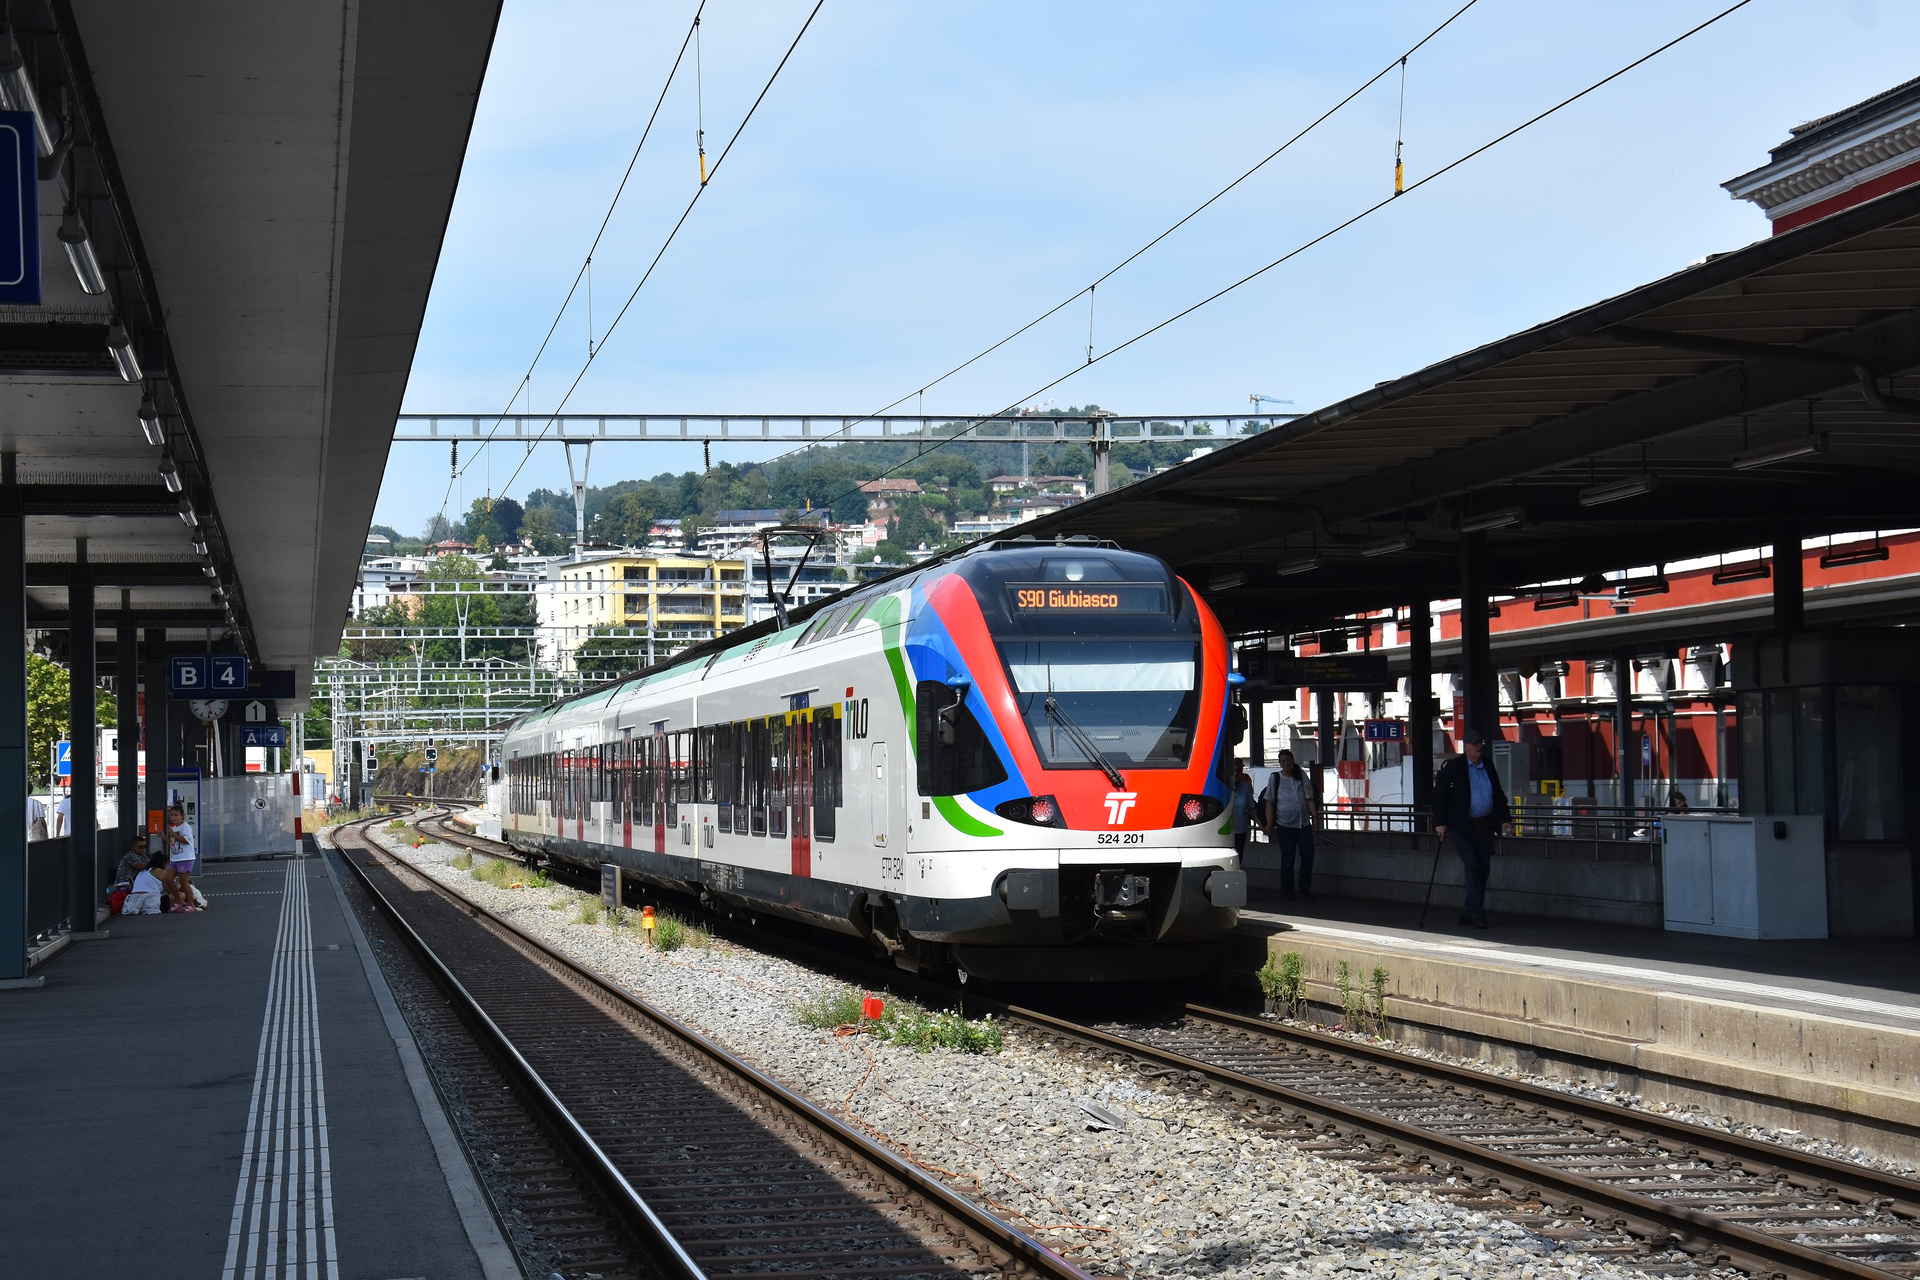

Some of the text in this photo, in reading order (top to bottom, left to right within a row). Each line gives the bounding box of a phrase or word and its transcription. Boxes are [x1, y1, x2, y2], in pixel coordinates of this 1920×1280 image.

[1017, 590, 1118, 608] S90 Giubiasco
[181, 667, 197, 685] B
[221, 667, 235, 685] 4
[252, 704, 258, 720] 1
[246, 733, 257, 744] A
[270, 733, 279, 743] 4
[1372, 727, 1378, 737] 1
[1389, 727, 1397, 737] E
[1097, 833, 1144, 844] 524 201
[882, 857, 904, 880] ETR 524
